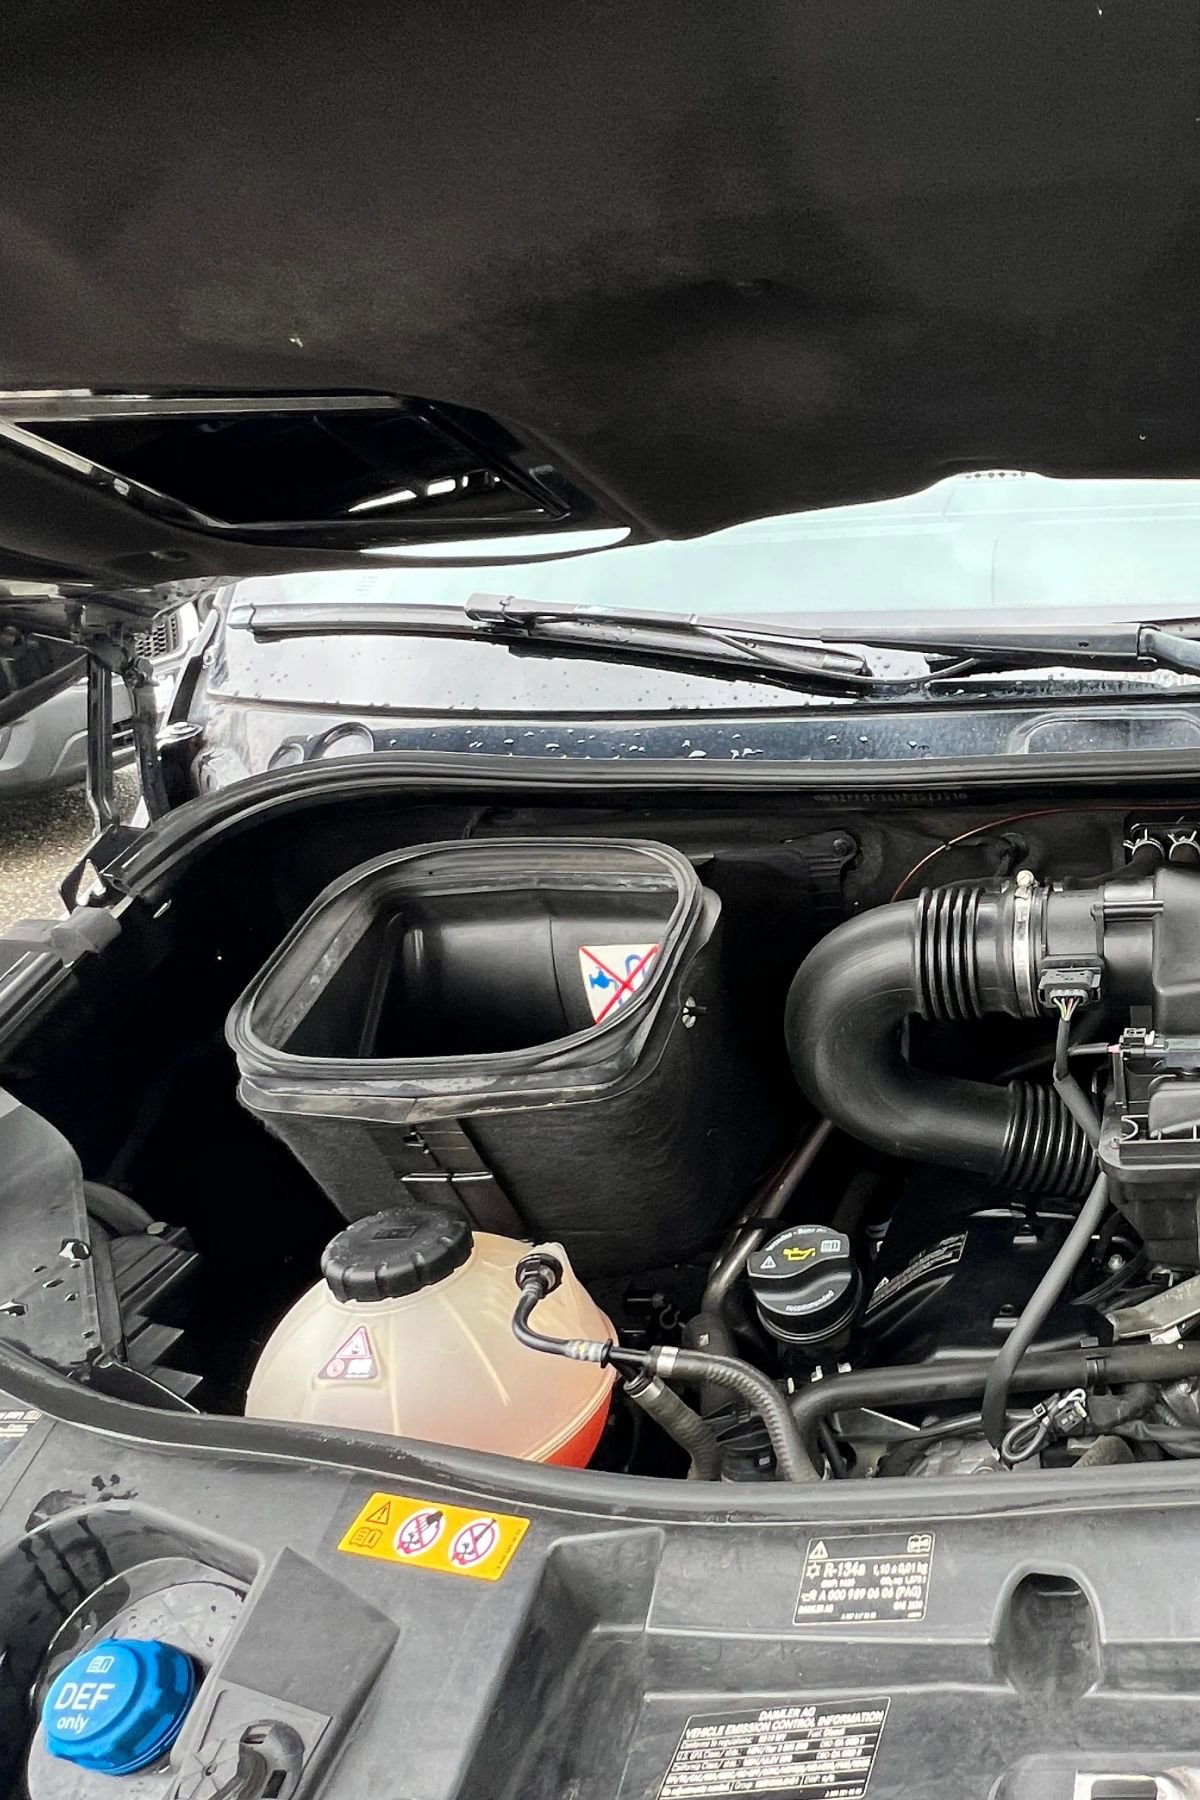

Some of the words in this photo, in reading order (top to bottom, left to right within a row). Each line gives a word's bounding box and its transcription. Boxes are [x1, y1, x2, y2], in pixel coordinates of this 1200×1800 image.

[786, 1289, 835, 1312] recommended
[823, 1561, 866, 1578] R-134a
[818, 1590, 826, 1601] A
[827, 1589, 847, 1601] 000
[54, 1682, 116, 1711] DEF
[56, 1713, 90, 1735] only
[685, 1725, 725, 1740] VEHICLE
[725, 1721, 772, 1737] EMISSION
[771, 1717, 816, 1732] CONTROL
[817, 1710, 885, 1727] INFORMATION
